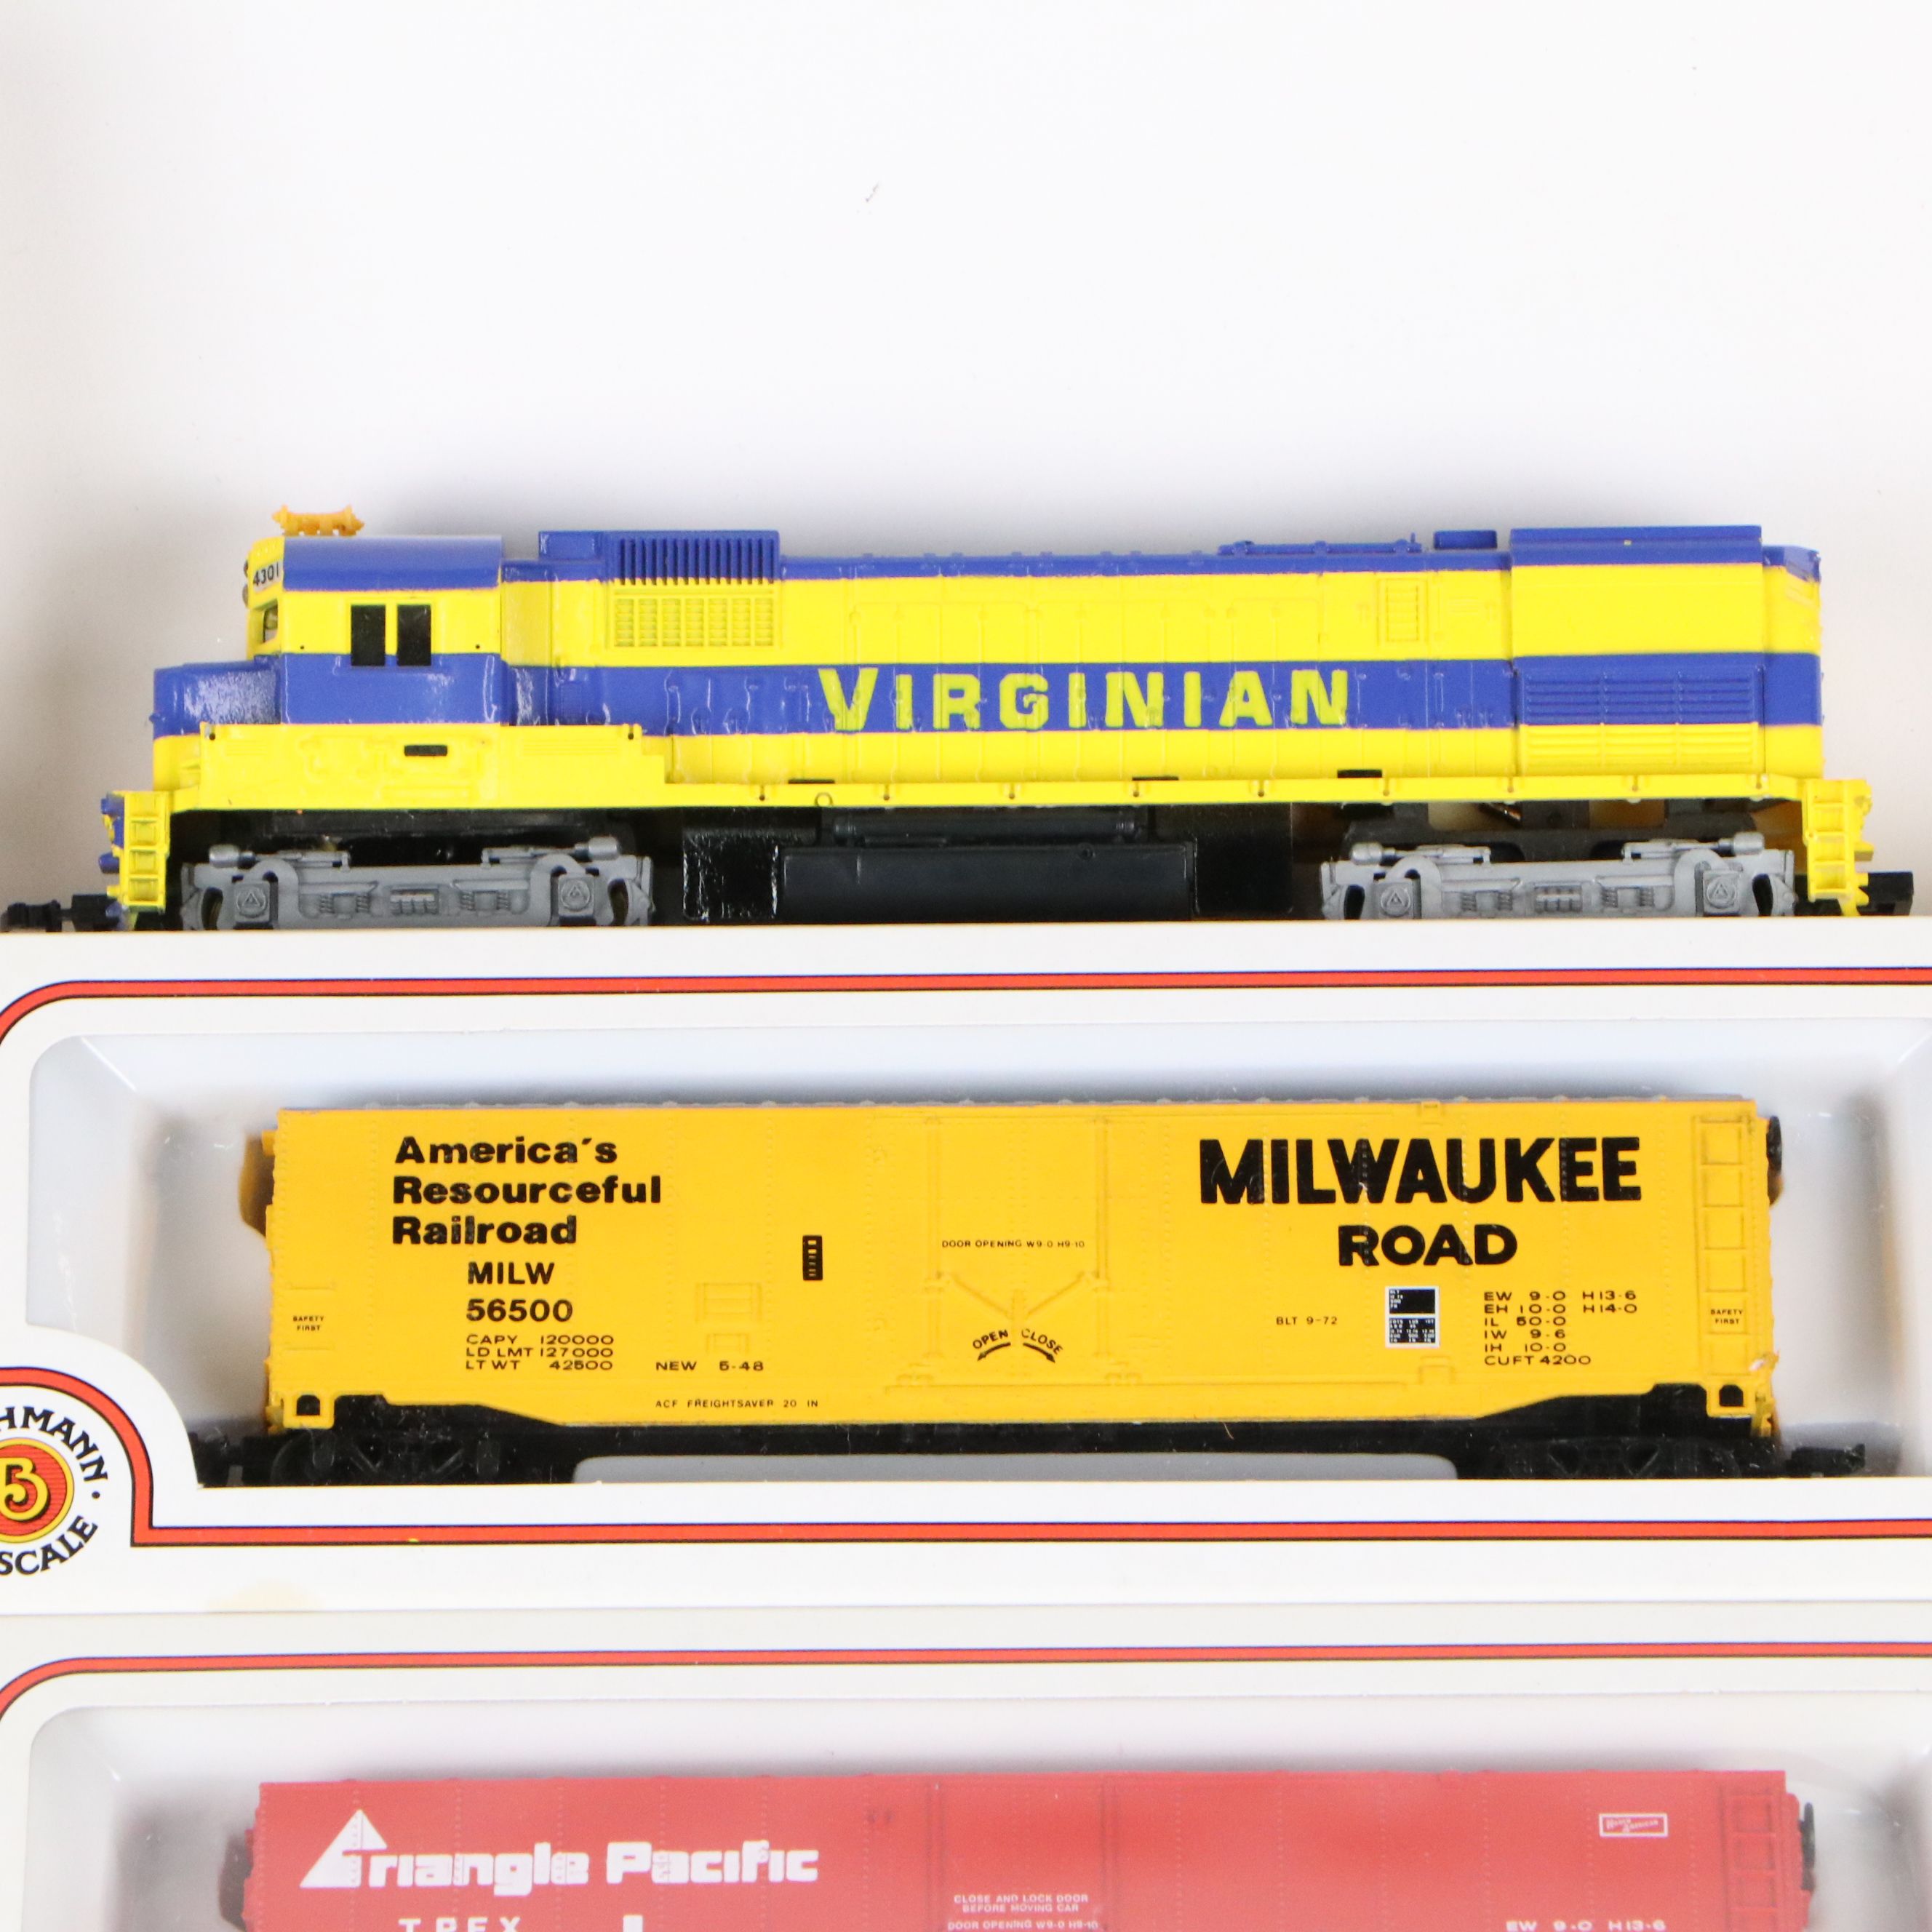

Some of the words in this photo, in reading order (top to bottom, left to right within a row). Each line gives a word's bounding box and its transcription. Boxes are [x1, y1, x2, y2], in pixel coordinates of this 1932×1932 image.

[252, 561, 279, 586] 4301
[818, 667, 1348, 730] VIRGINIAN
[395, 1136, 618, 1164] America's
[1199, 1137, 1642, 1204] MILWAUKEE
[393, 1175, 660, 1204] Resourceful
[393, 1215, 577, 1245] Railroad
[942, 1240, 971, 1248] DOOR
[975, 1240, 1022, 1248] OPENING
[1338, 1224, 1517, 1266] ROAD
[468, 1261, 555, 1284] MILW
[1484, 1291, 1512, 1301] EW
[1529, 1291, 1566, 1301] 9-0
[466, 1298, 573, 1322] 56500
[1484, 1304, 1508, 1314] EH
[1520, 1304, 1566, 1314] 10-0
[1276, 1316, 1298, 1325] BLT
[1306, 1316, 1337, 1325] 9-72
[1485, 1317, 1498, 1326] IL
[1517, 1316, 1566, 1326] 50-0
[466, 1334, 517, 1344] CAPY
[540, 1335, 614, 1345] 120000
[973, 1329, 1009, 1349] OPEN
[1485, 1330, 1506, 1339] IW
[1530, 1329, 1566, 1338] 9-6
[1021, 1328, 1063, 1355] CLOSE
[1485, 1344, 1502, 1352] IH
[1525, 1342, 1566, 1352] 10-0
[466, 1347, 490, 1357] LD
[497, 1347, 533, 1357] LMT
[540, 1347, 613, 1357] 127000
[466, 1360, 486, 1370] LT
[492, 1360, 520, 1370] WT
[549, 1360, 612, 1370] 42500
[1485, 1355, 1534, 1365] CUFT
[1540, 1354, 1591, 1365] 4200
[655, 1361, 697, 1370] NEW
[655, 1400, 678, 1408] ACF
[687, 1399, 774, 1408] FREIGHTSAVER
[783, 1400, 797, 1408] 20
[807, 1400, 818, 1408] IN
[300, 1808, 589, 1896] Triangle
[606, 1840, 819, 1884] Pacific
[954, 1894, 990, 1903] CLOSE
[996, 1894, 1018, 1903] AND
[1023, 1894, 1052, 1903] LOCK
[1057, 1894, 1088, 1903] DOOR
[962, 1904, 1005, 1912] BEFORE
[1011, 1904, 1052, 1912] MOVING
[1057, 1904, 1079, 1912] CAR
[948, 1921, 978, 1931] DOOR
[983, 1920, 1031, 1930] OPENING
[1506, 1920, 1536, 1931] EW
